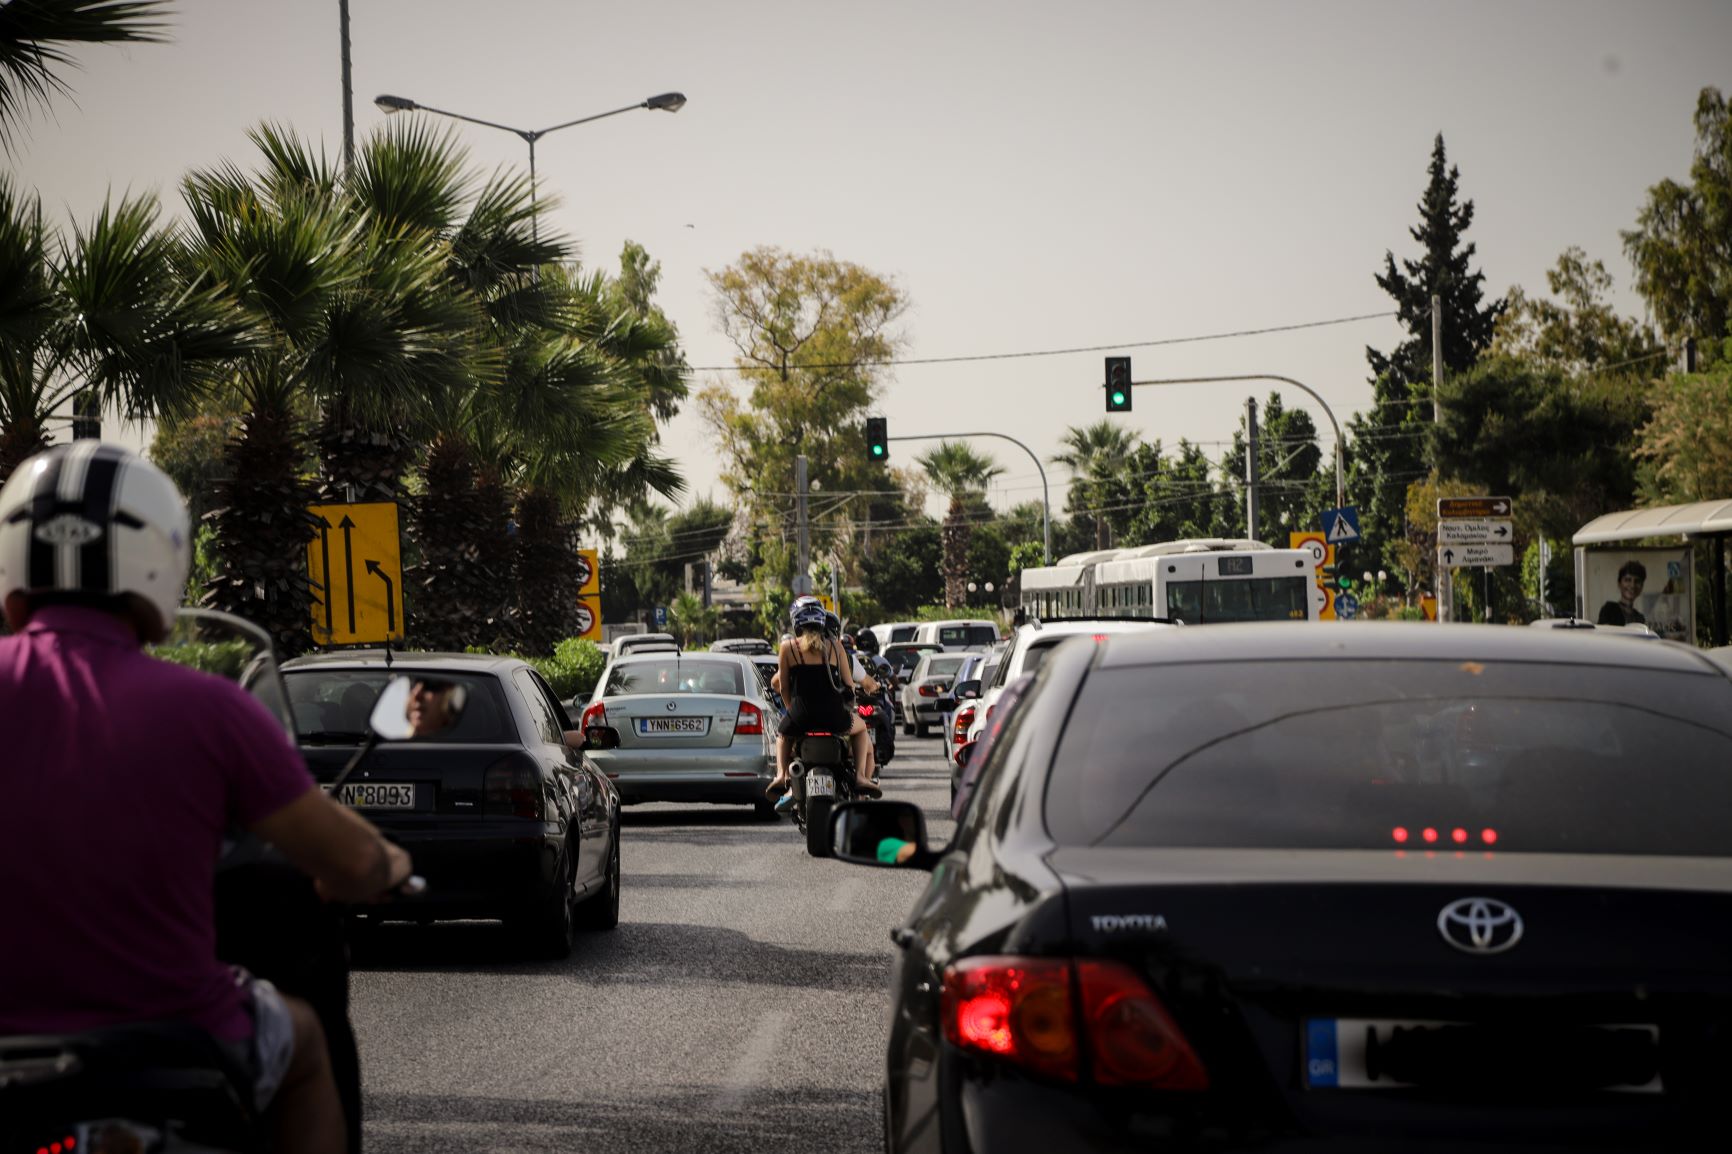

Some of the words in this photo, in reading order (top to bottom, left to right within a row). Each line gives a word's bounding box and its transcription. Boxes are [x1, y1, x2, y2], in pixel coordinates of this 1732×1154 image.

[655, 608, 664, 620] P
[650, 719, 672, 731] YNN
[675, 719, 701, 731] 6562
[366, 786, 411, 805] 8093
[1089, 914, 1168, 932] TOYOTA
[1308, 1058, 1334, 1076] GR
